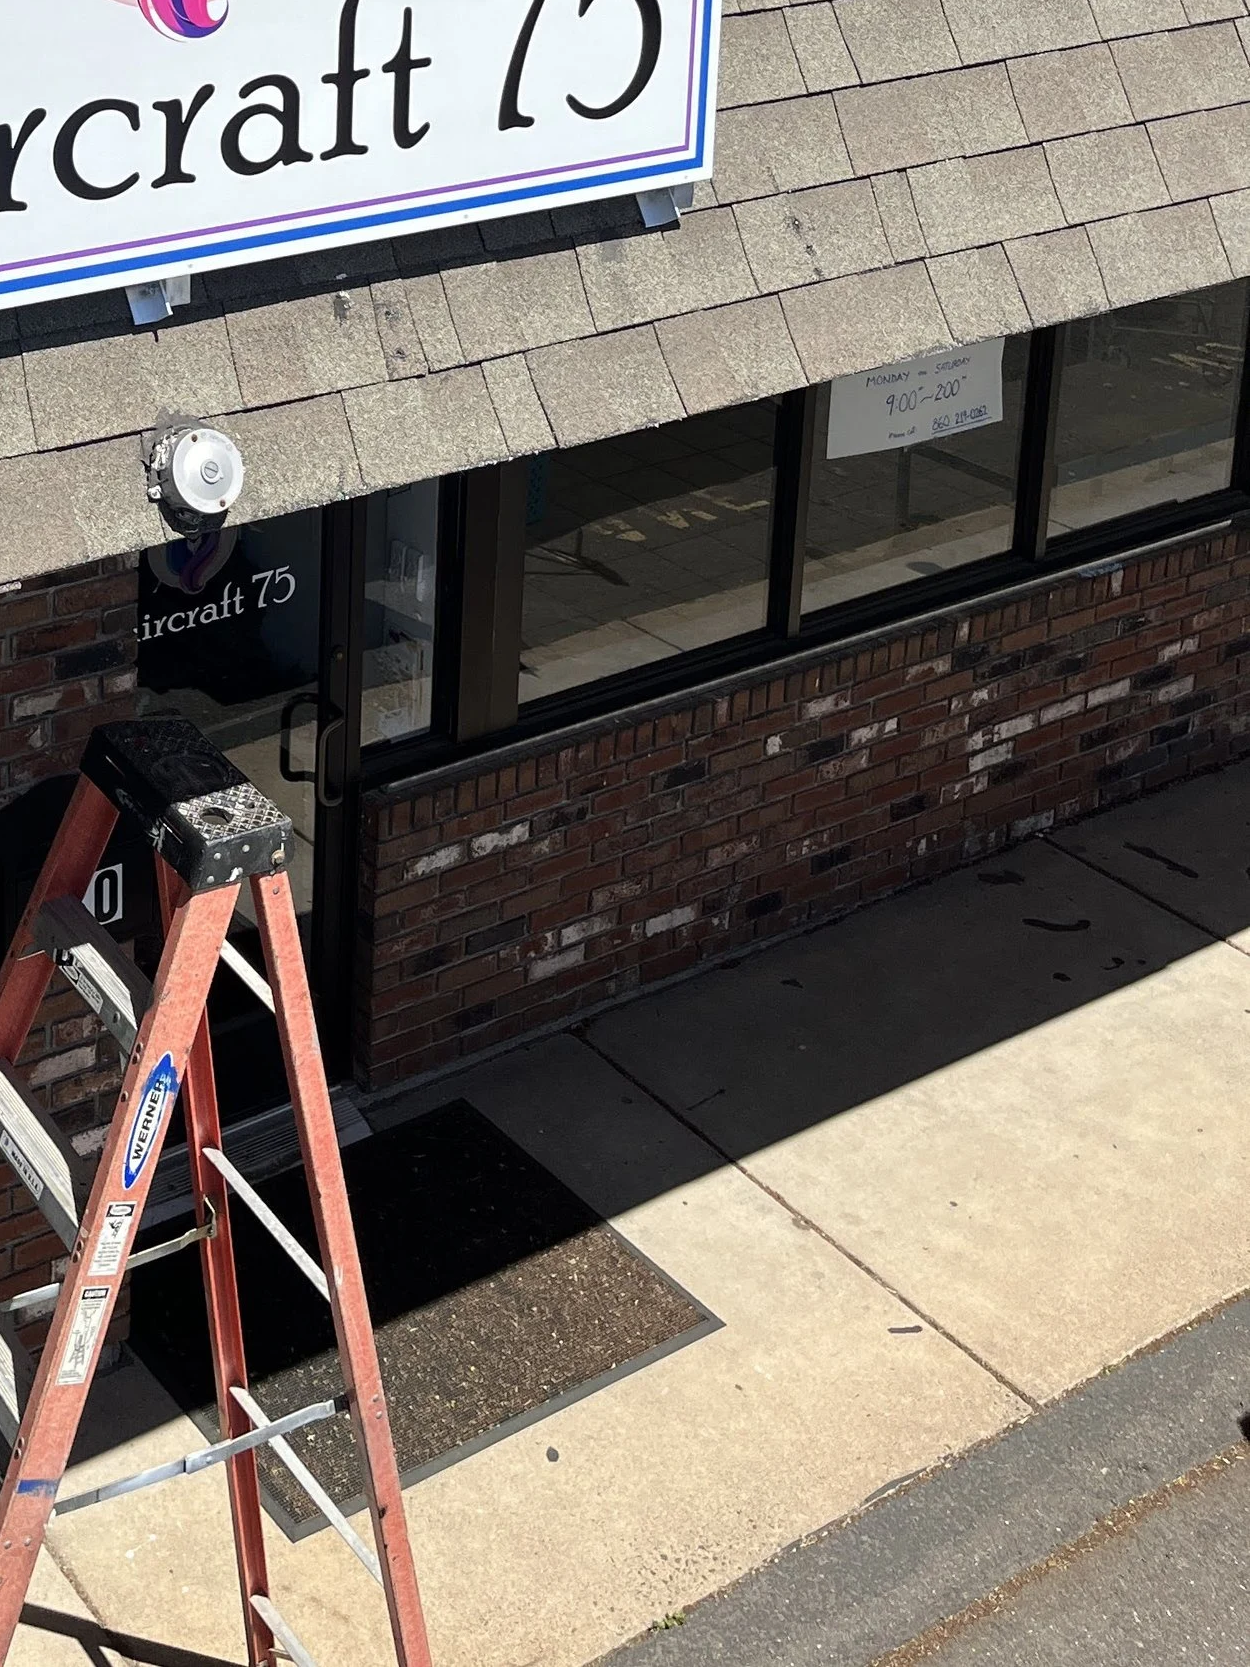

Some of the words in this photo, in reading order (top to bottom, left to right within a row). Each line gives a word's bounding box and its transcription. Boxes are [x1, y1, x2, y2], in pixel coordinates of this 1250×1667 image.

[866, 371, 910, 387] MONDAY
[935, 356, 971, 374] SATURDAY
[252, 565, 296, 609] 75
[132, 1078, 165, 1160] WERNER
